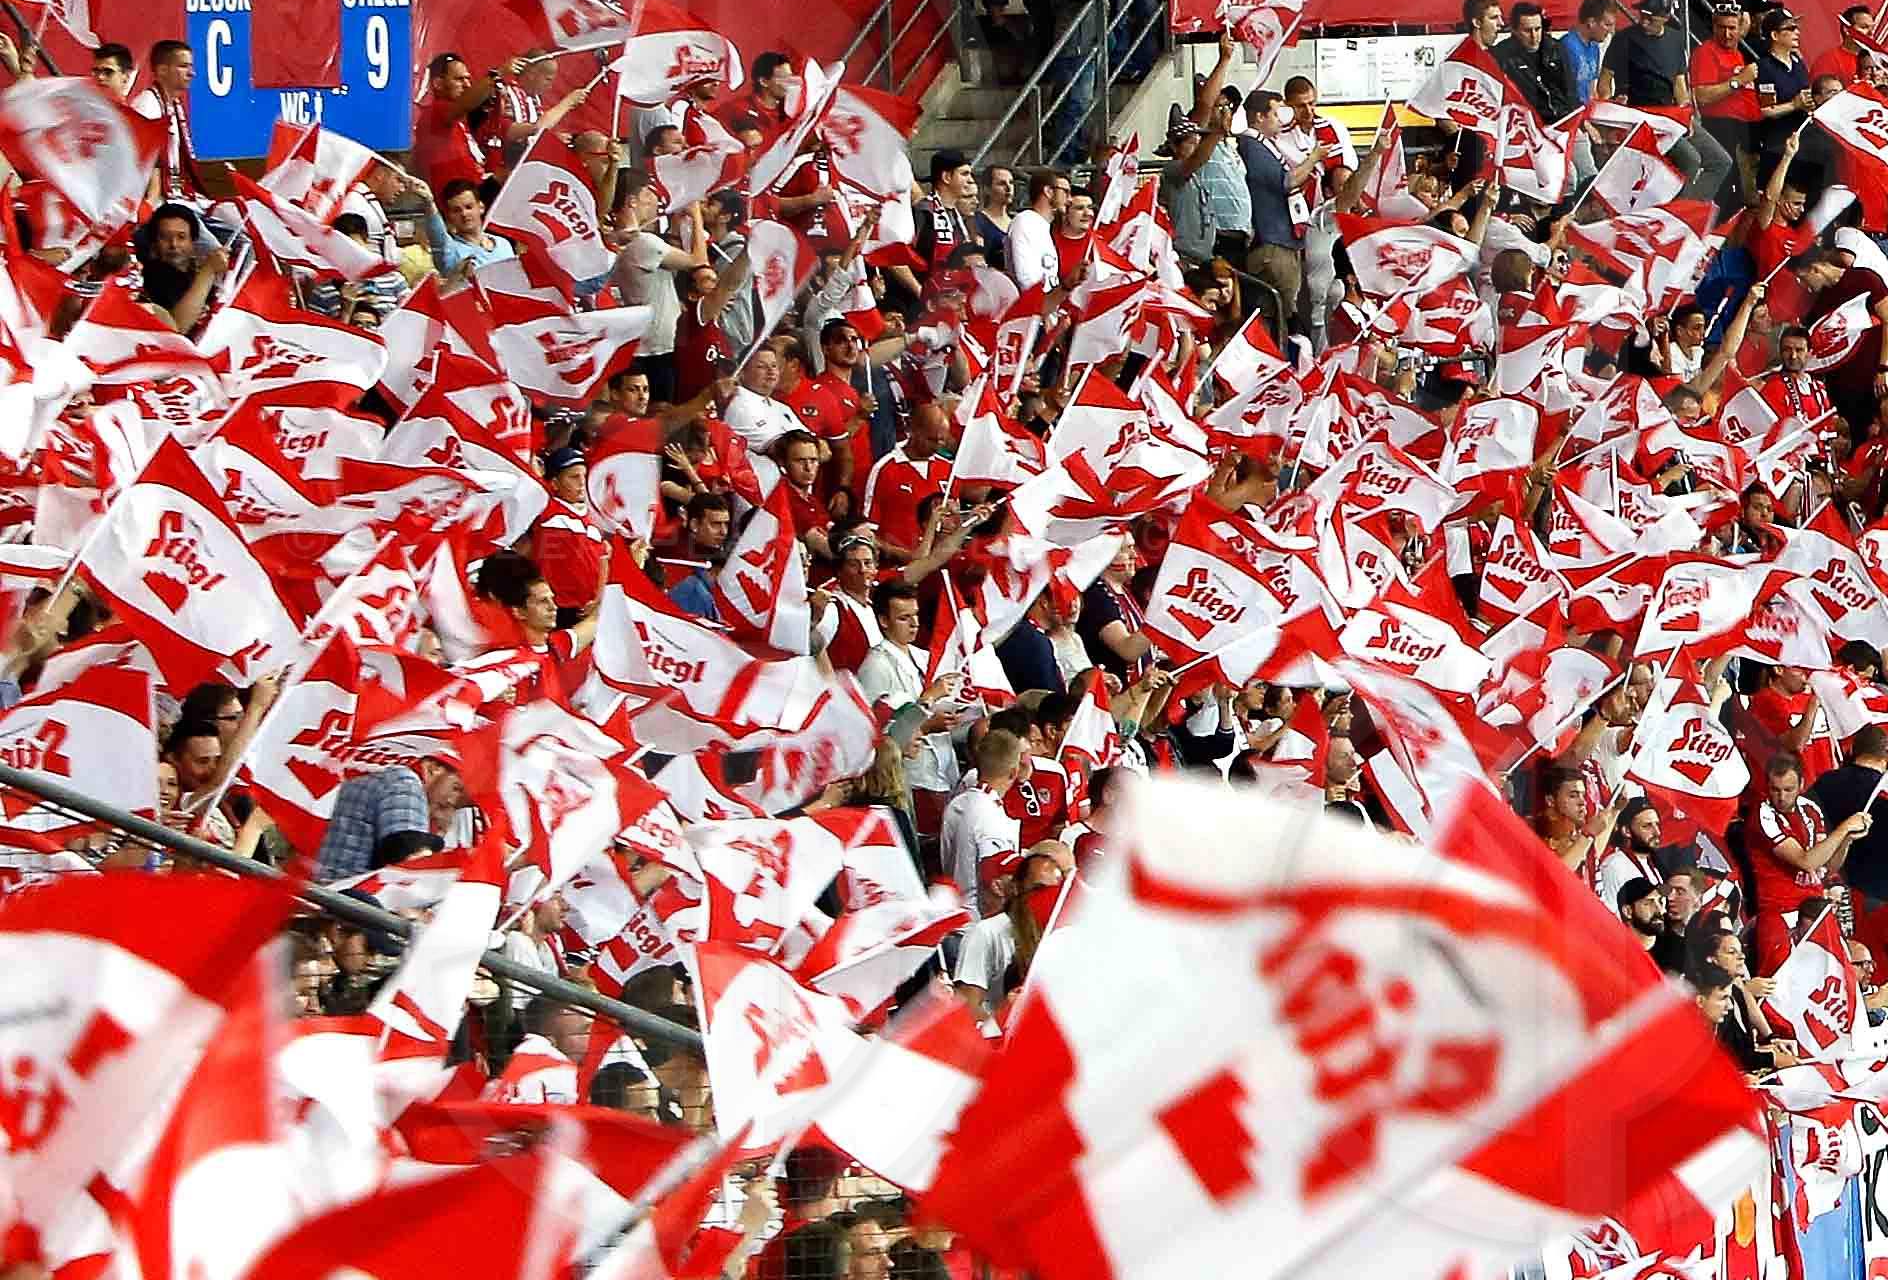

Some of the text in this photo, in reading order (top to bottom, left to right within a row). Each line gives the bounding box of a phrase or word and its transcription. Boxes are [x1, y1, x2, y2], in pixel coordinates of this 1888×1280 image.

[206, 19, 234, 98] C
[366, 15, 390, 90] 9
[280, 92, 311, 123] WC
[1454, 79, 1499, 124] Stiegl
[532, 181, 595, 238] Stiegl
[1346, 453, 1413, 495] Stiegl
[152, 513, 226, 591] Stiegl
[1499, 534, 1551, 581] Stiegl
[1168, 569, 1245, 623] Stiegl
[1813, 557, 1872, 607] Stiegl
[1368, 620, 1443, 663] Stiegl
[1669, 719, 1733, 762] Stiegl
